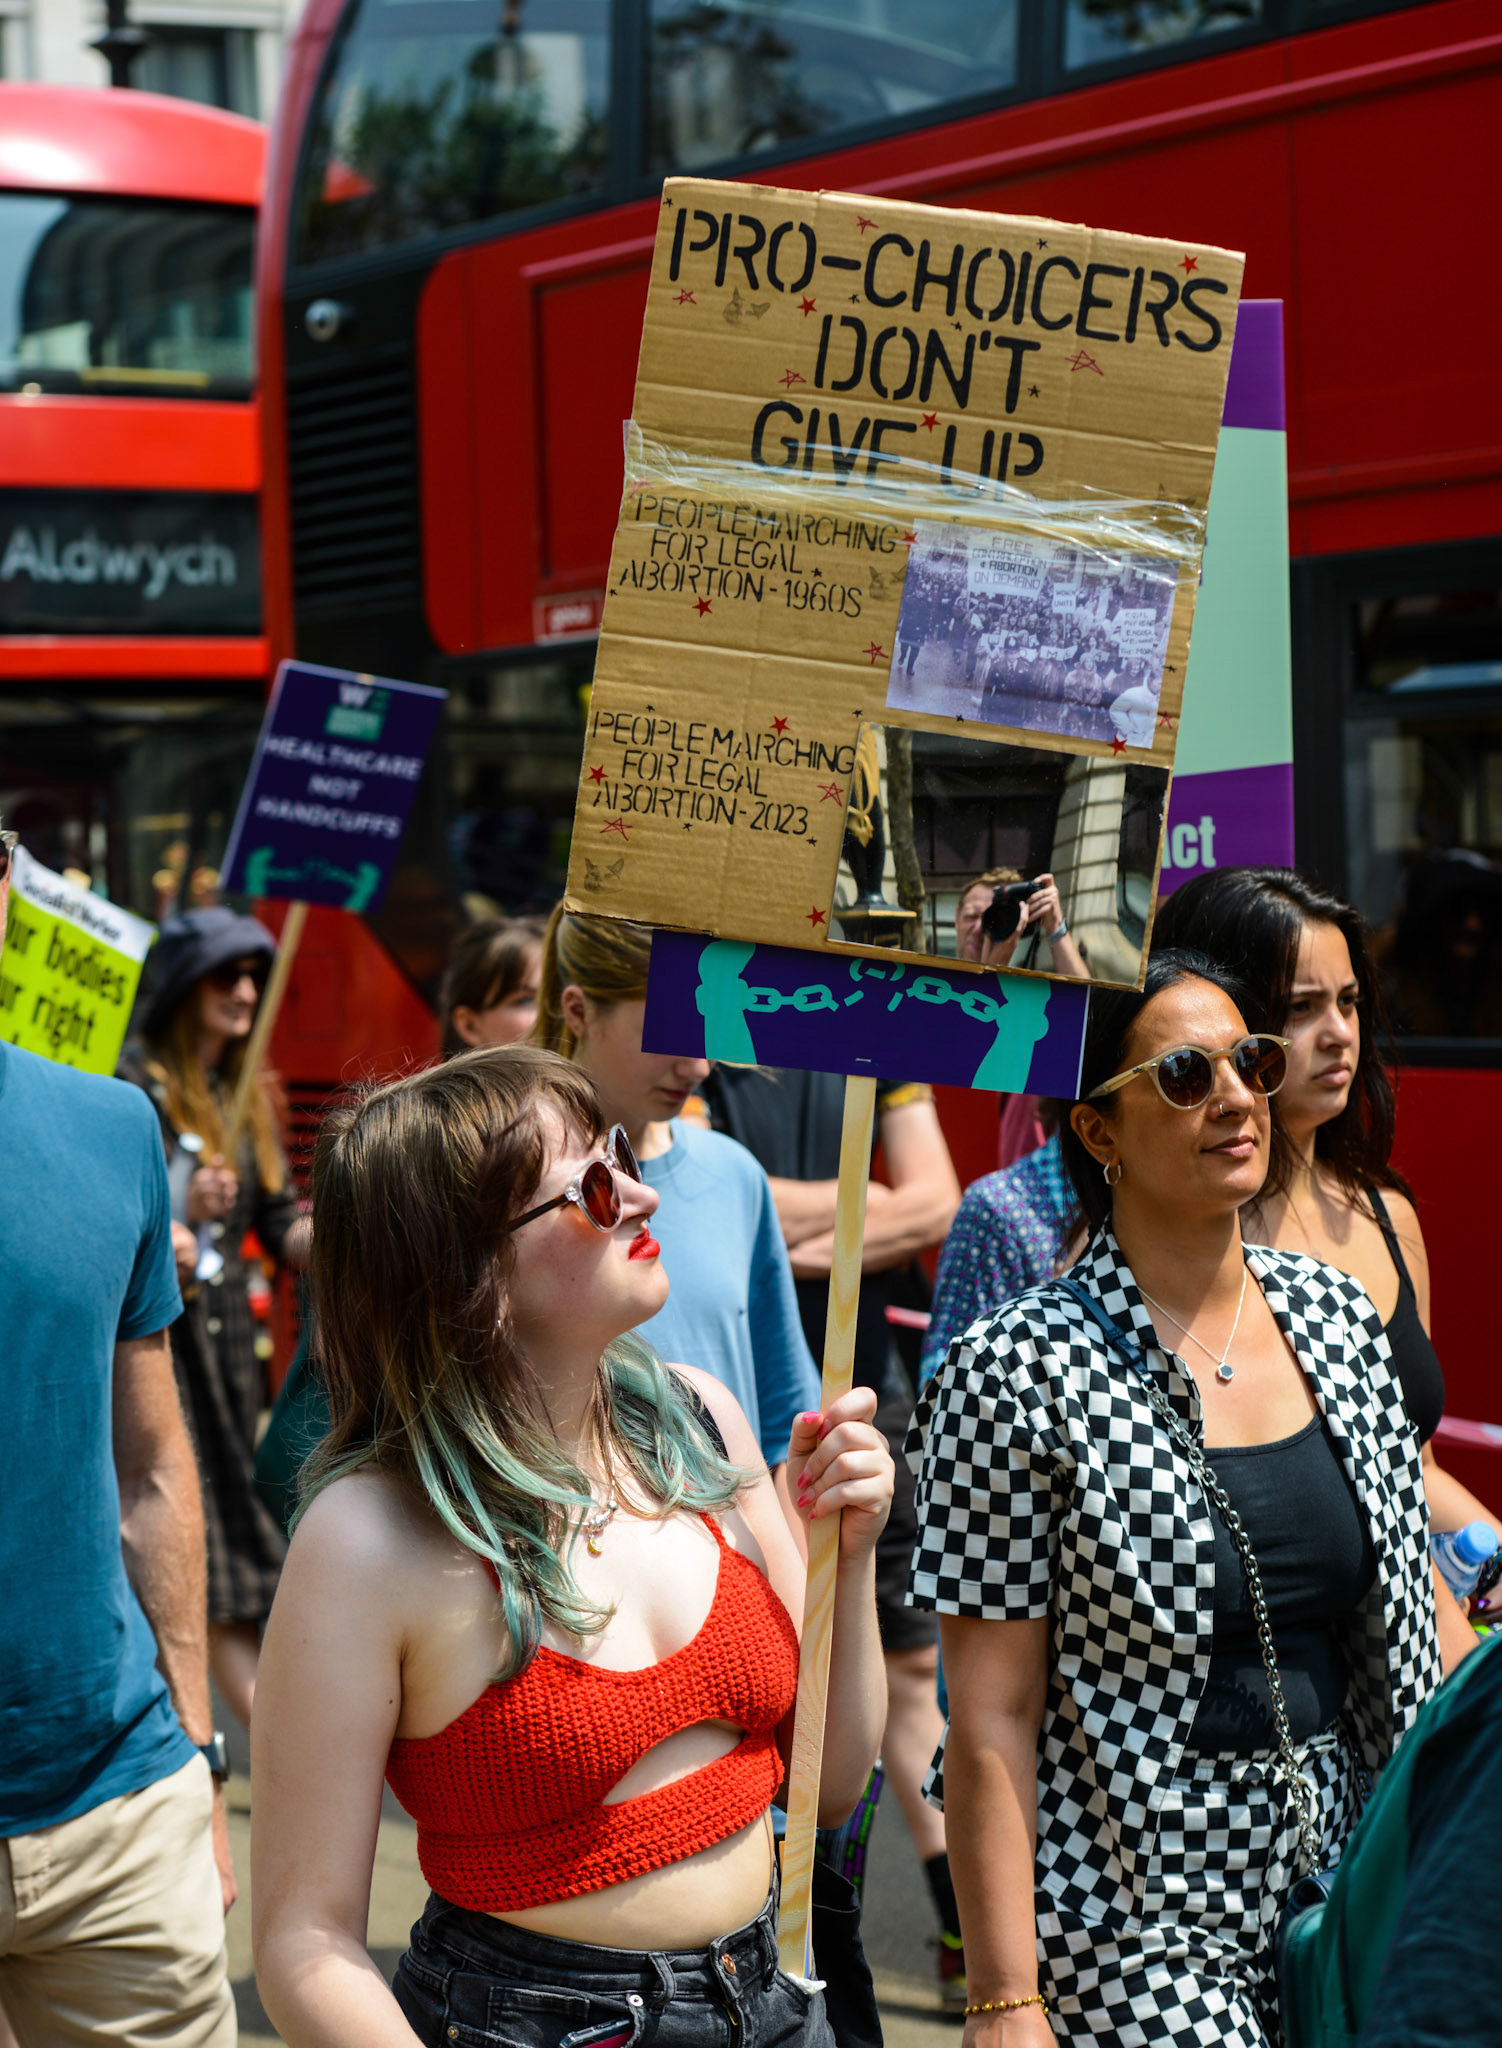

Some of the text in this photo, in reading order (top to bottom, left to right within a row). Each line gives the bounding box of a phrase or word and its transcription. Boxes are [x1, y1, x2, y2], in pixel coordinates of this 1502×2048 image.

[669, 208, 1229, 352] PRO-CHOICERS
[814, 314, 1042, 414] DON'T
[751, 401, 1044, 502] GIVE UP
[636, 494, 898, 554] PEOPLE MARCHING
[992, 536, 1033, 554] FREE
[0, 525, 236, 599] Aldwych
[651, 529, 803, 575] FOR LEGAL
[989, 560, 1038, 577] ABORTION
[974, 571, 1041, 590] ON DEMAND
[265, 735, 423, 781] HEALTHCARE
[592, 711, 856, 775] PEOPLE MARCHING
[308, 773, 363, 801] NOT
[622, 750, 768, 798] FOR LEGAL
[256, 795, 401, 839] HANDCUFFS
[47, 925, 127, 1007] bodies
[31, 987, 96, 1058] right
